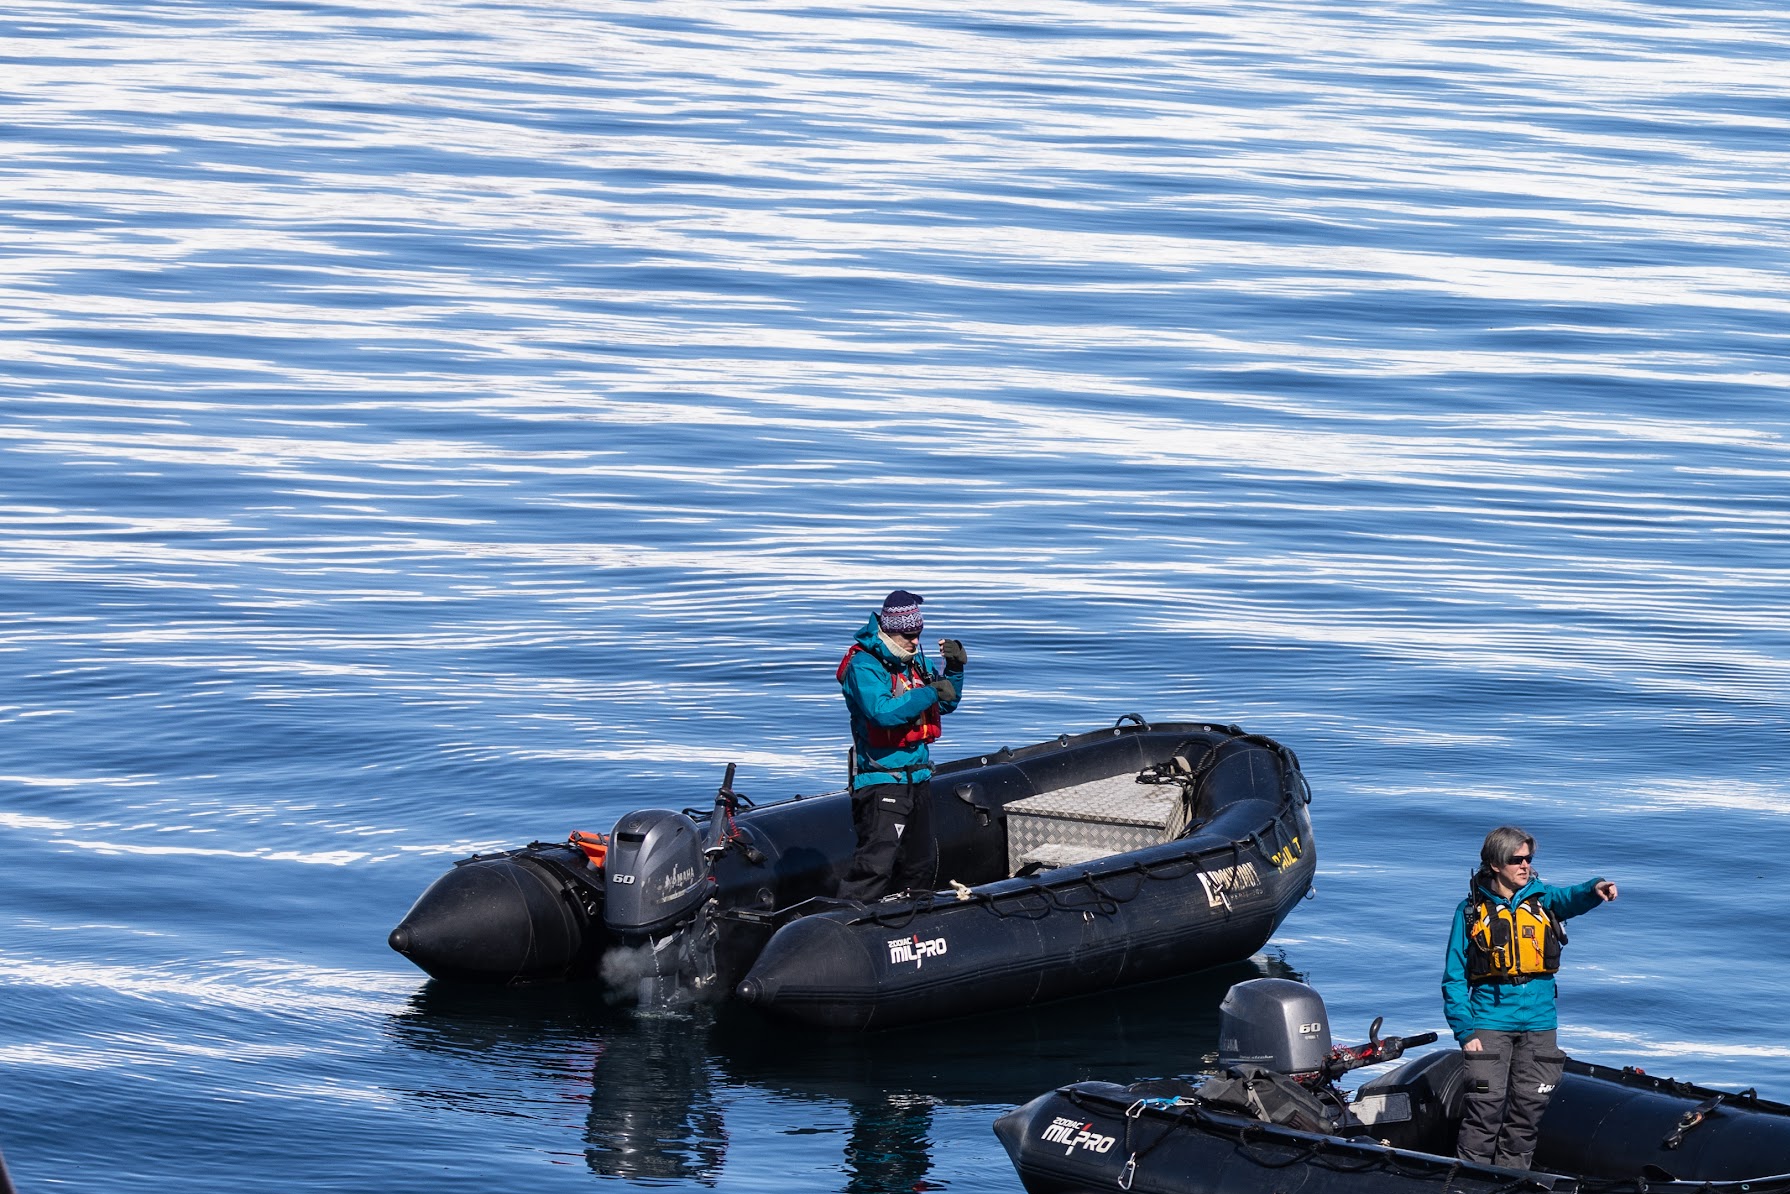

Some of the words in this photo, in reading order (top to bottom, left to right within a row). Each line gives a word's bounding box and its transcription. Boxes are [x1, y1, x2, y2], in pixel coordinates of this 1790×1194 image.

[613, 873, 635, 885] 60
[887, 937, 913, 948] ZODIAC
[890, 937, 948, 969] MILPRO
[1299, 1022, 1321, 1034] 60
[1053, 1116, 1085, 1130] ZODIAC
[1041, 1123, 1116, 1156] MILPRO
